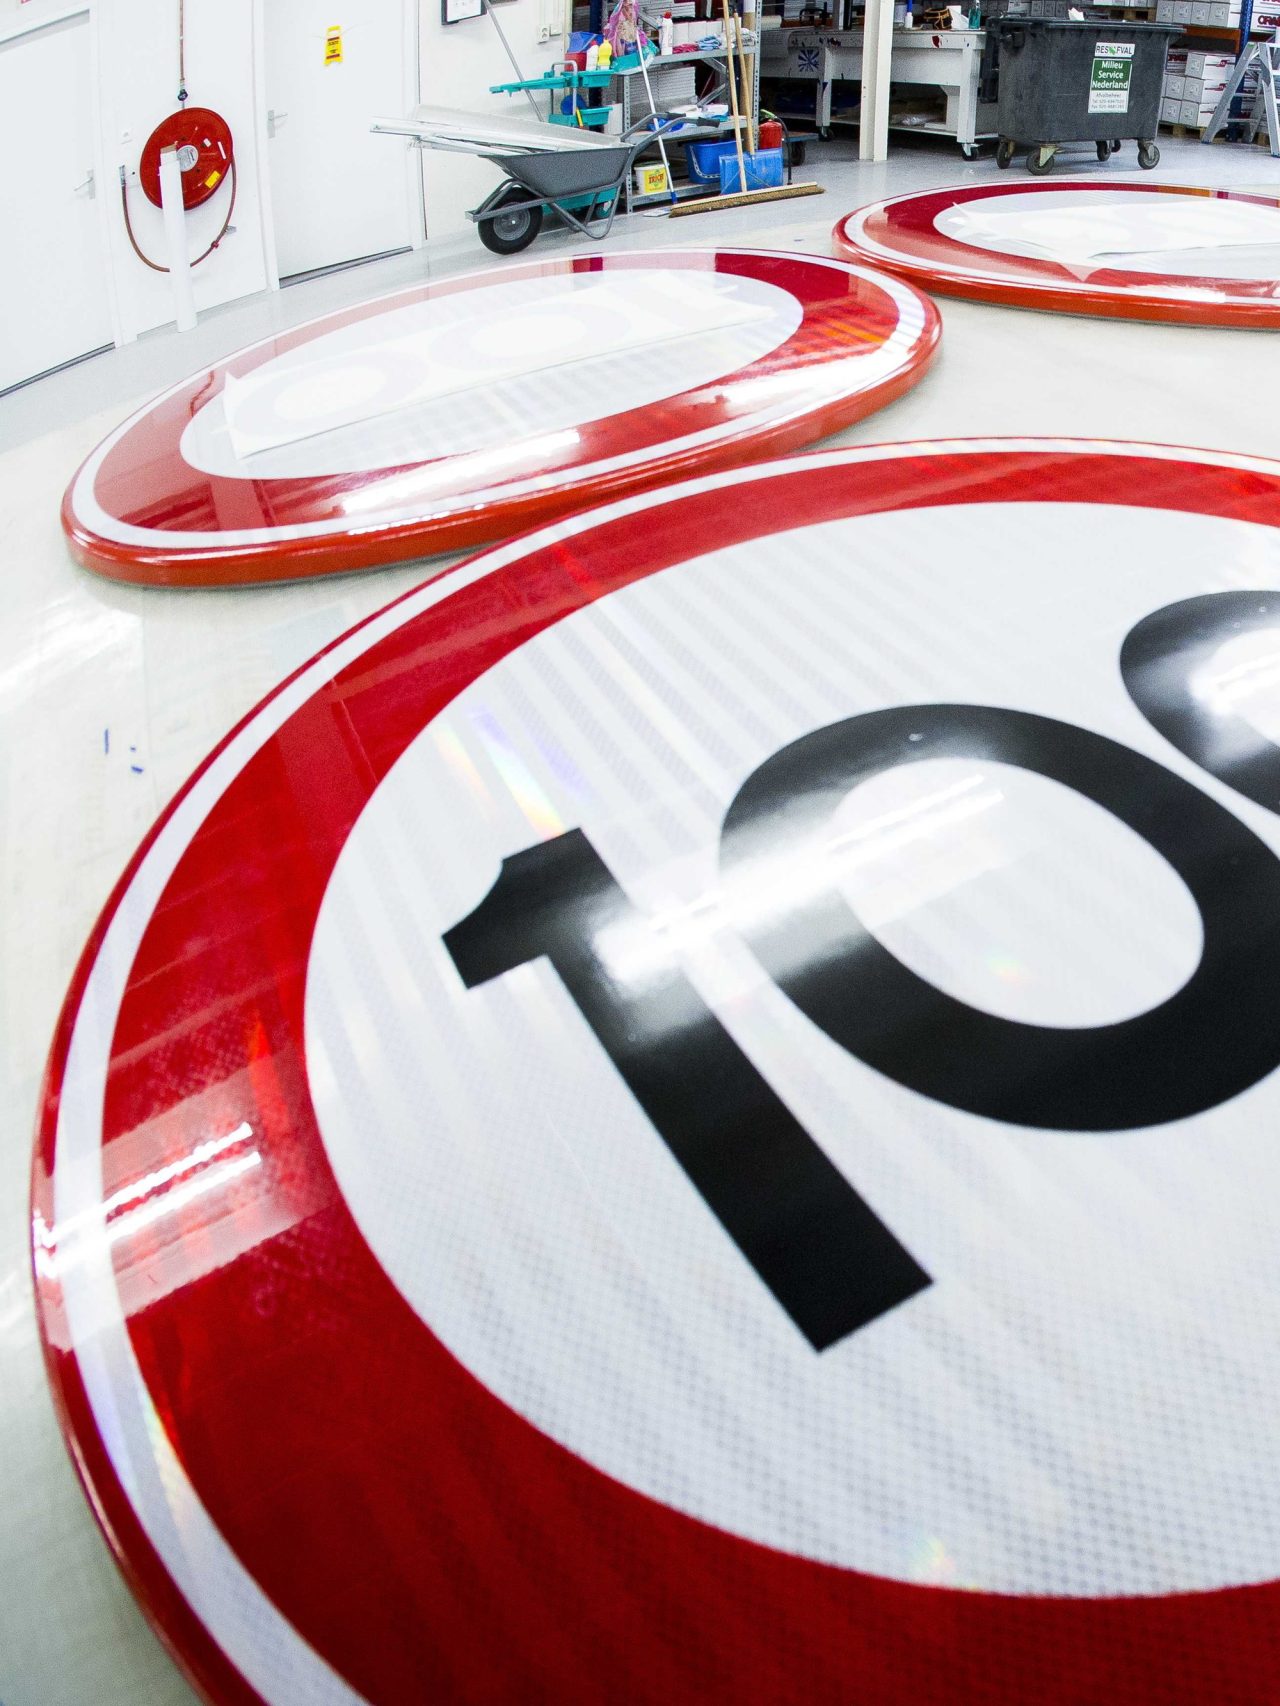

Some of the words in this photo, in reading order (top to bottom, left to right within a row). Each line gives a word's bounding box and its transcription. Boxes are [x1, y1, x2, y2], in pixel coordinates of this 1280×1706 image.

[1095, 45, 1133, 55] RESFVAL
[1101, 60, 1124, 69] Milieu
[1097, 70, 1124, 79] Service
[1092, 80, 1129, 89] Nederland
